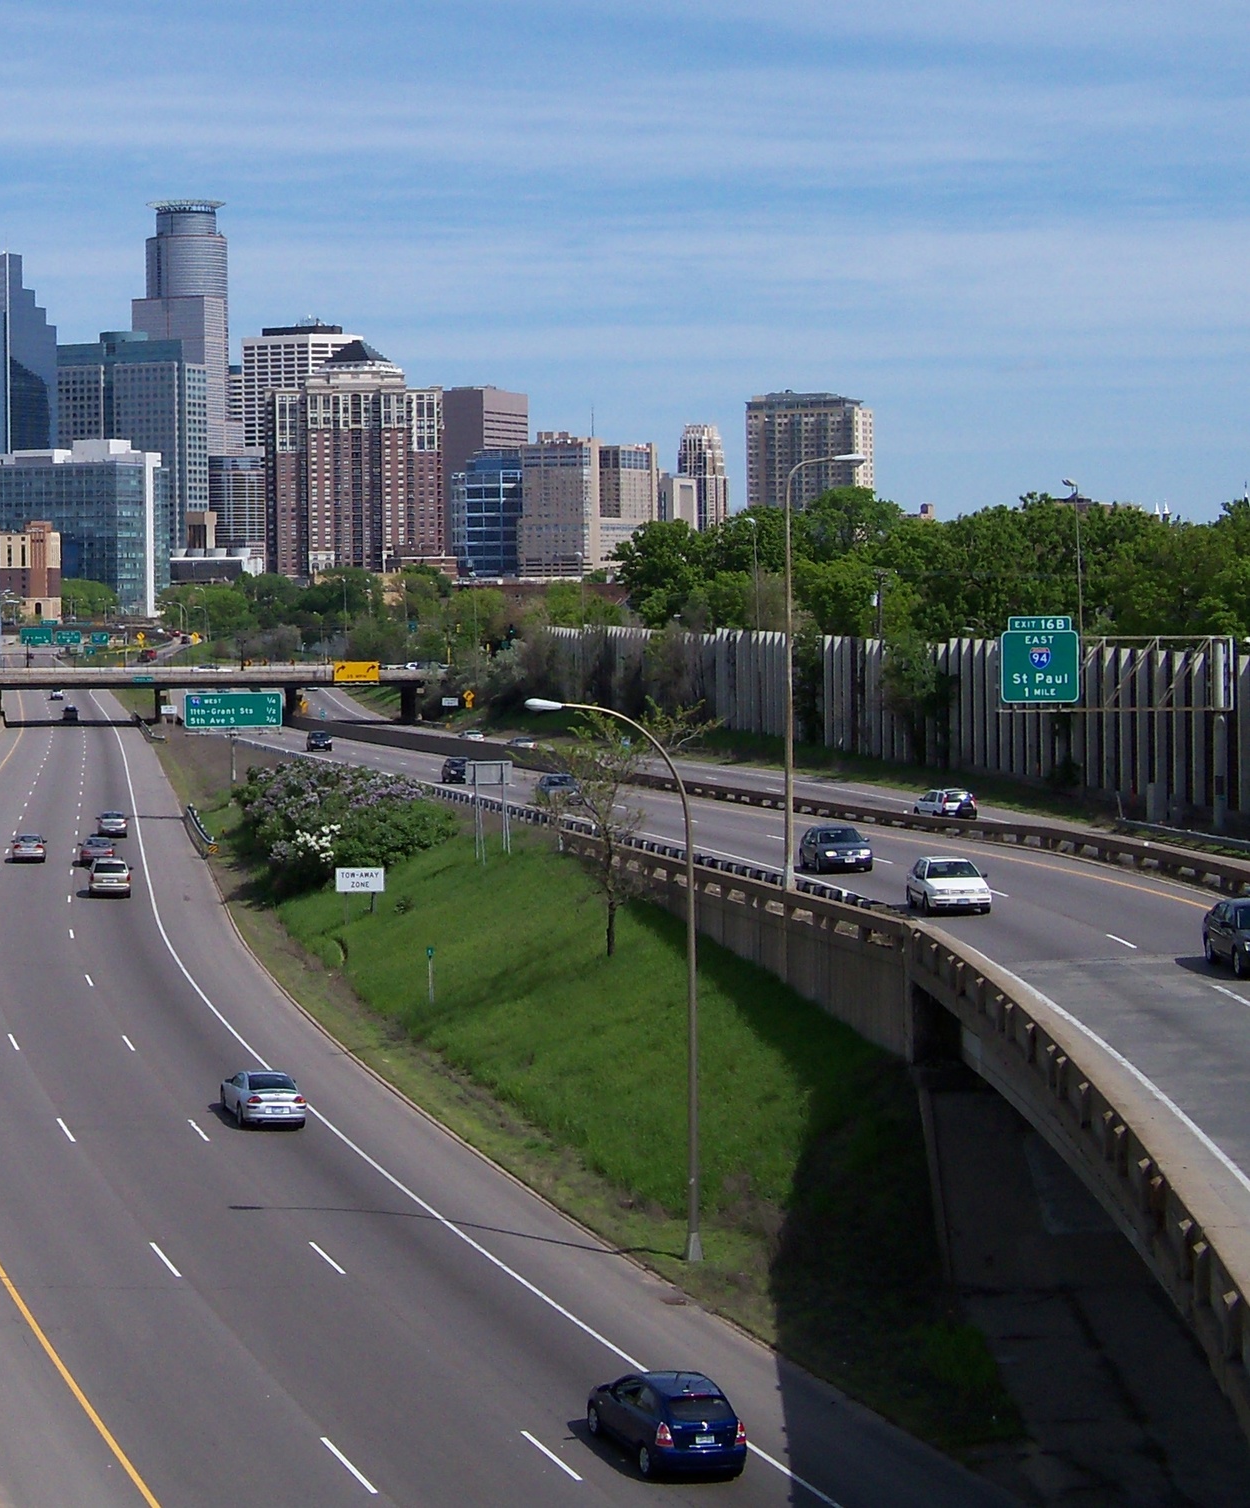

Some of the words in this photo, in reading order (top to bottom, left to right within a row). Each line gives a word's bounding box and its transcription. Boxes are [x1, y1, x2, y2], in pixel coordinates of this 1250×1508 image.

[1014, 620, 1036, 629] EXIT
[1040, 619, 1065, 630] 16B
[1024, 635, 1054, 645] EAST
[1032, 653, 1048, 664] 94
[1012, 673, 1028, 684] St
[1035, 673, 1069, 684] Paul
[1024, 687, 1029, 697] 1
[1034, 688, 1056, 696] MILE
[189, 707, 236, 715] 11th-Grant
[239, 707, 254, 715] Sts
[189, 717, 206, 725] 5th
